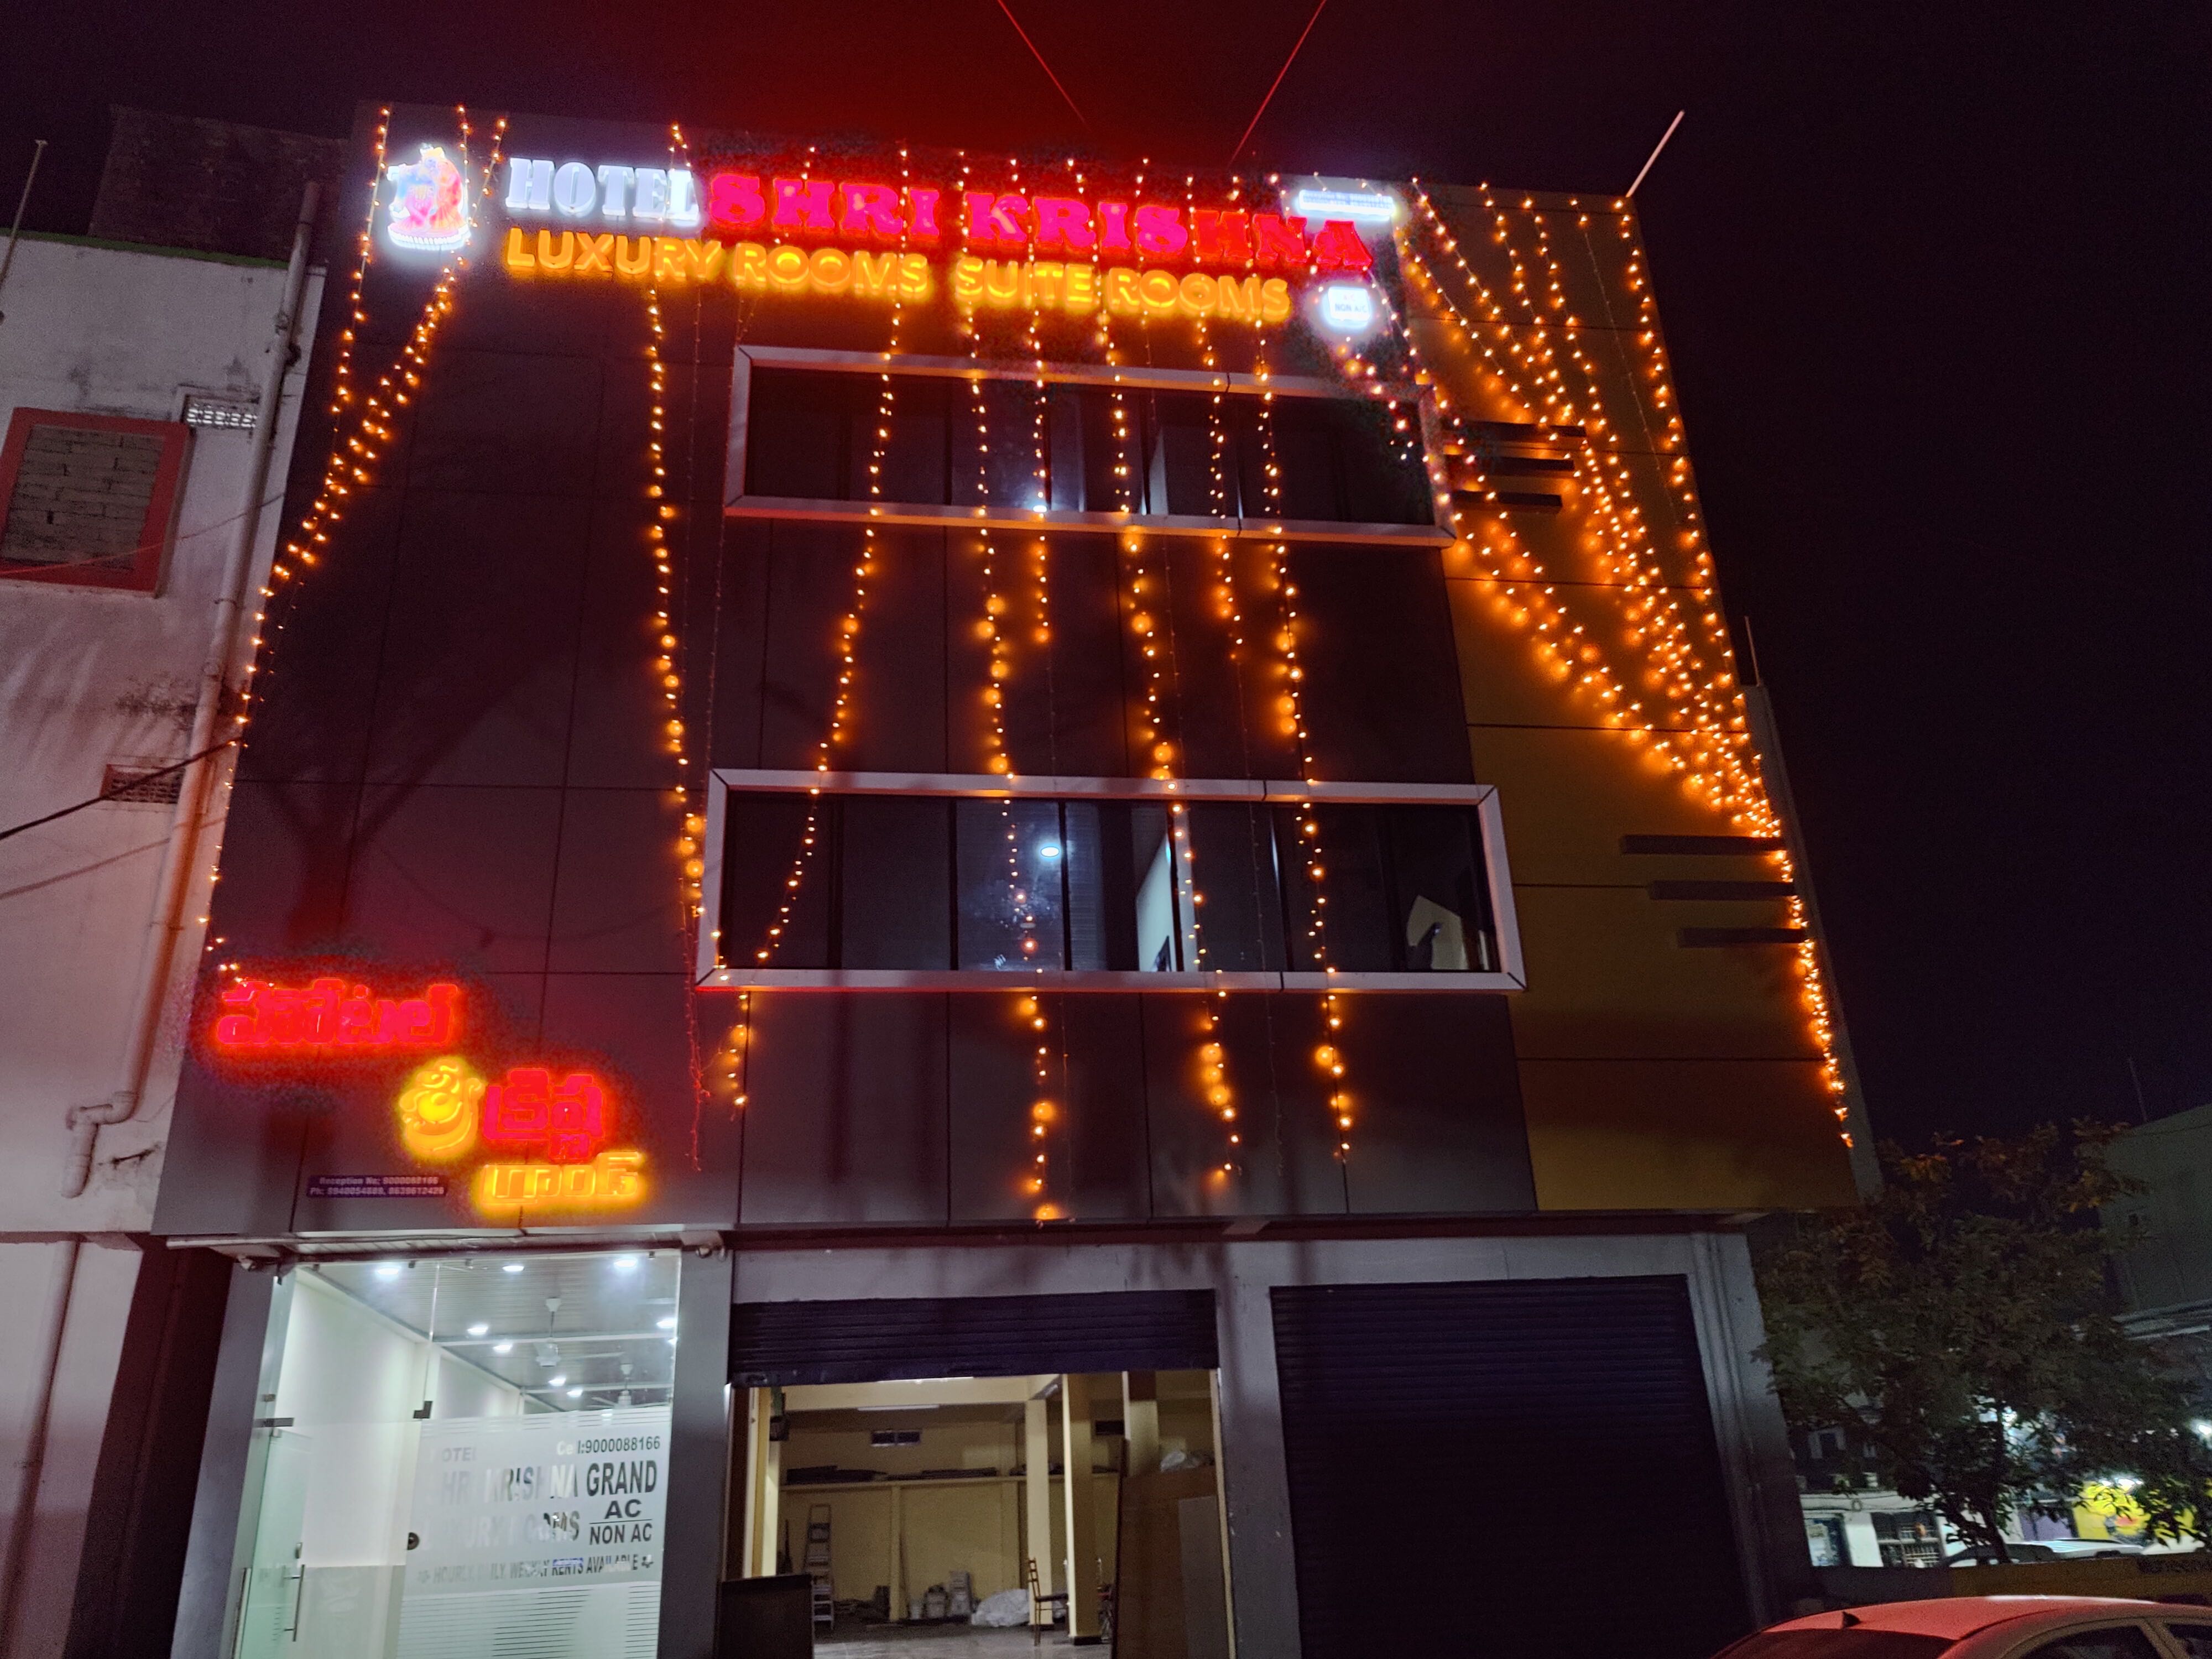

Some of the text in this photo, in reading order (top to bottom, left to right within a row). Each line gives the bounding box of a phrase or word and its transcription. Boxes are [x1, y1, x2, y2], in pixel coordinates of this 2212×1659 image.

[507, 157, 1374, 268] HOTEL SHRI KRISHNA
[507, 228, 1290, 321] LUXURY ROOMS SUITE ROOMS
[1334, 303, 1352, 312] NON
[557, 1436, 661, 1455] Cel:9000088166
[587, 1460, 658, 1497] GRAND
[604, 1499, 642, 1520] AC
[589, 1522, 653, 1546] NON AC
